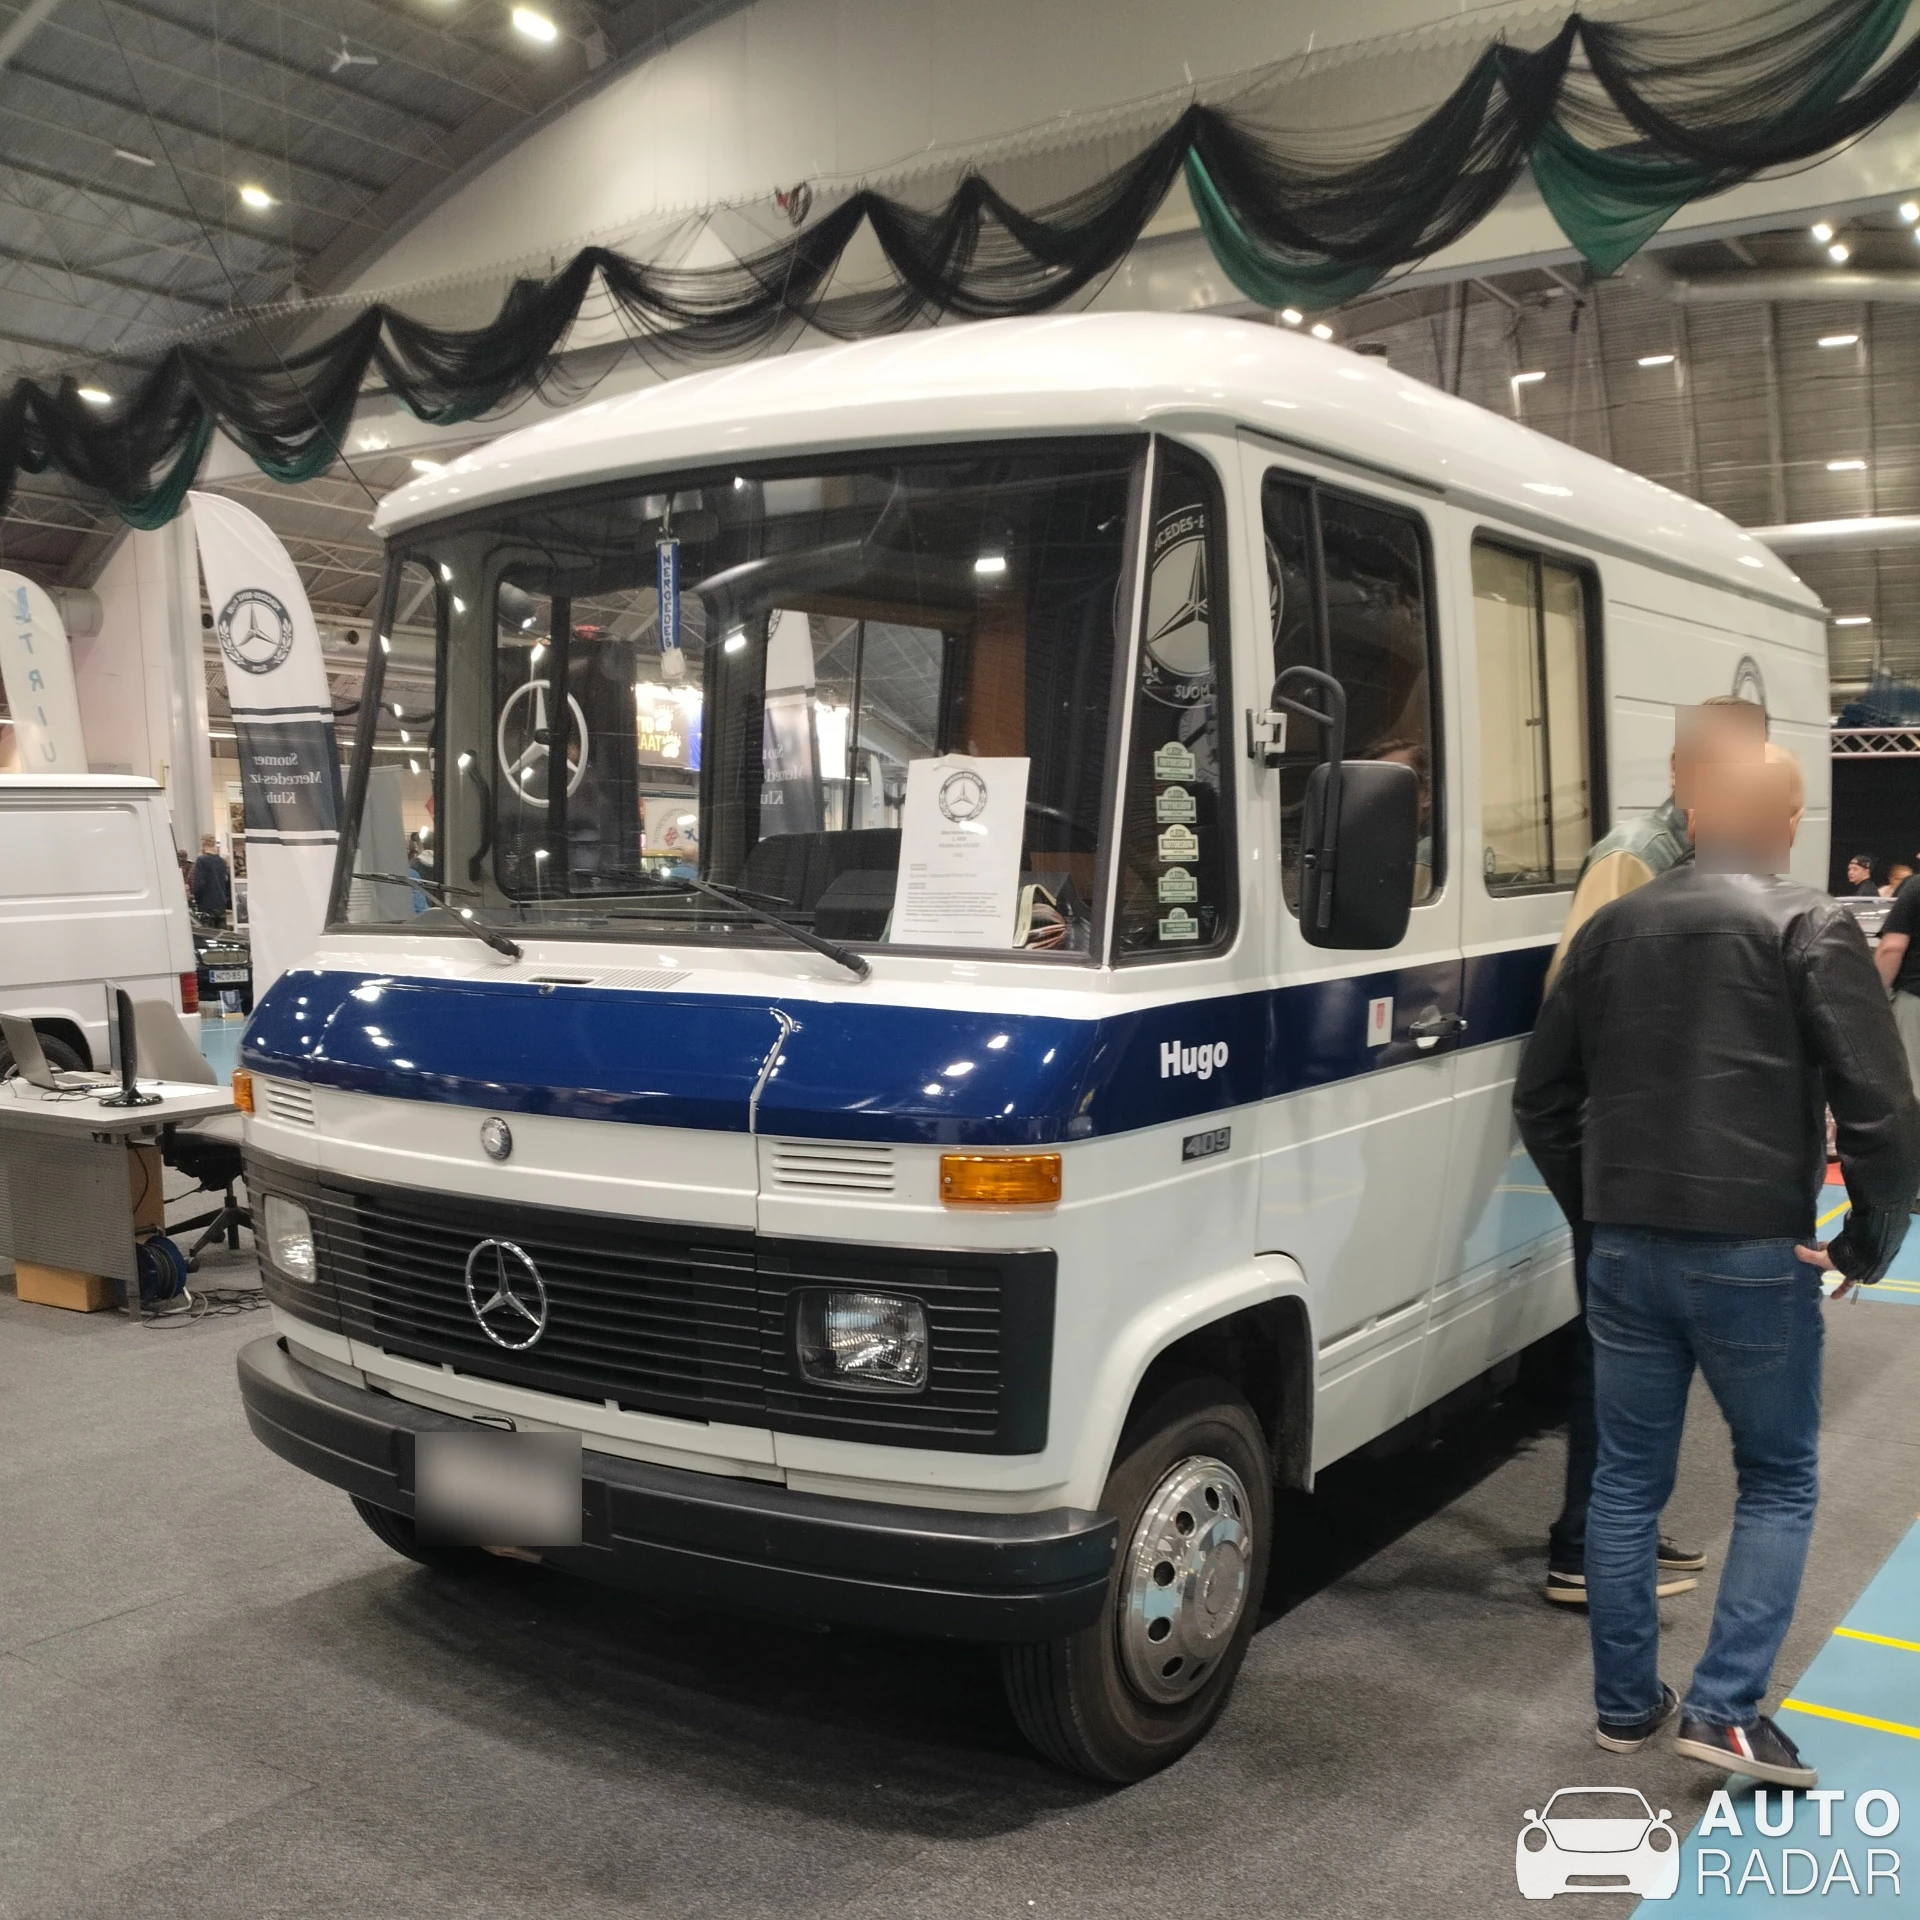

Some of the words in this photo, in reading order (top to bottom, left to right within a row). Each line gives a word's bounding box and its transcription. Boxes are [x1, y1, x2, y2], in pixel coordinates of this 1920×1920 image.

[638, 734, 662, 752] AAT
[1160, 1040, 1229, 1080] Hugo
[1185, 1128, 1230, 1156] 409
